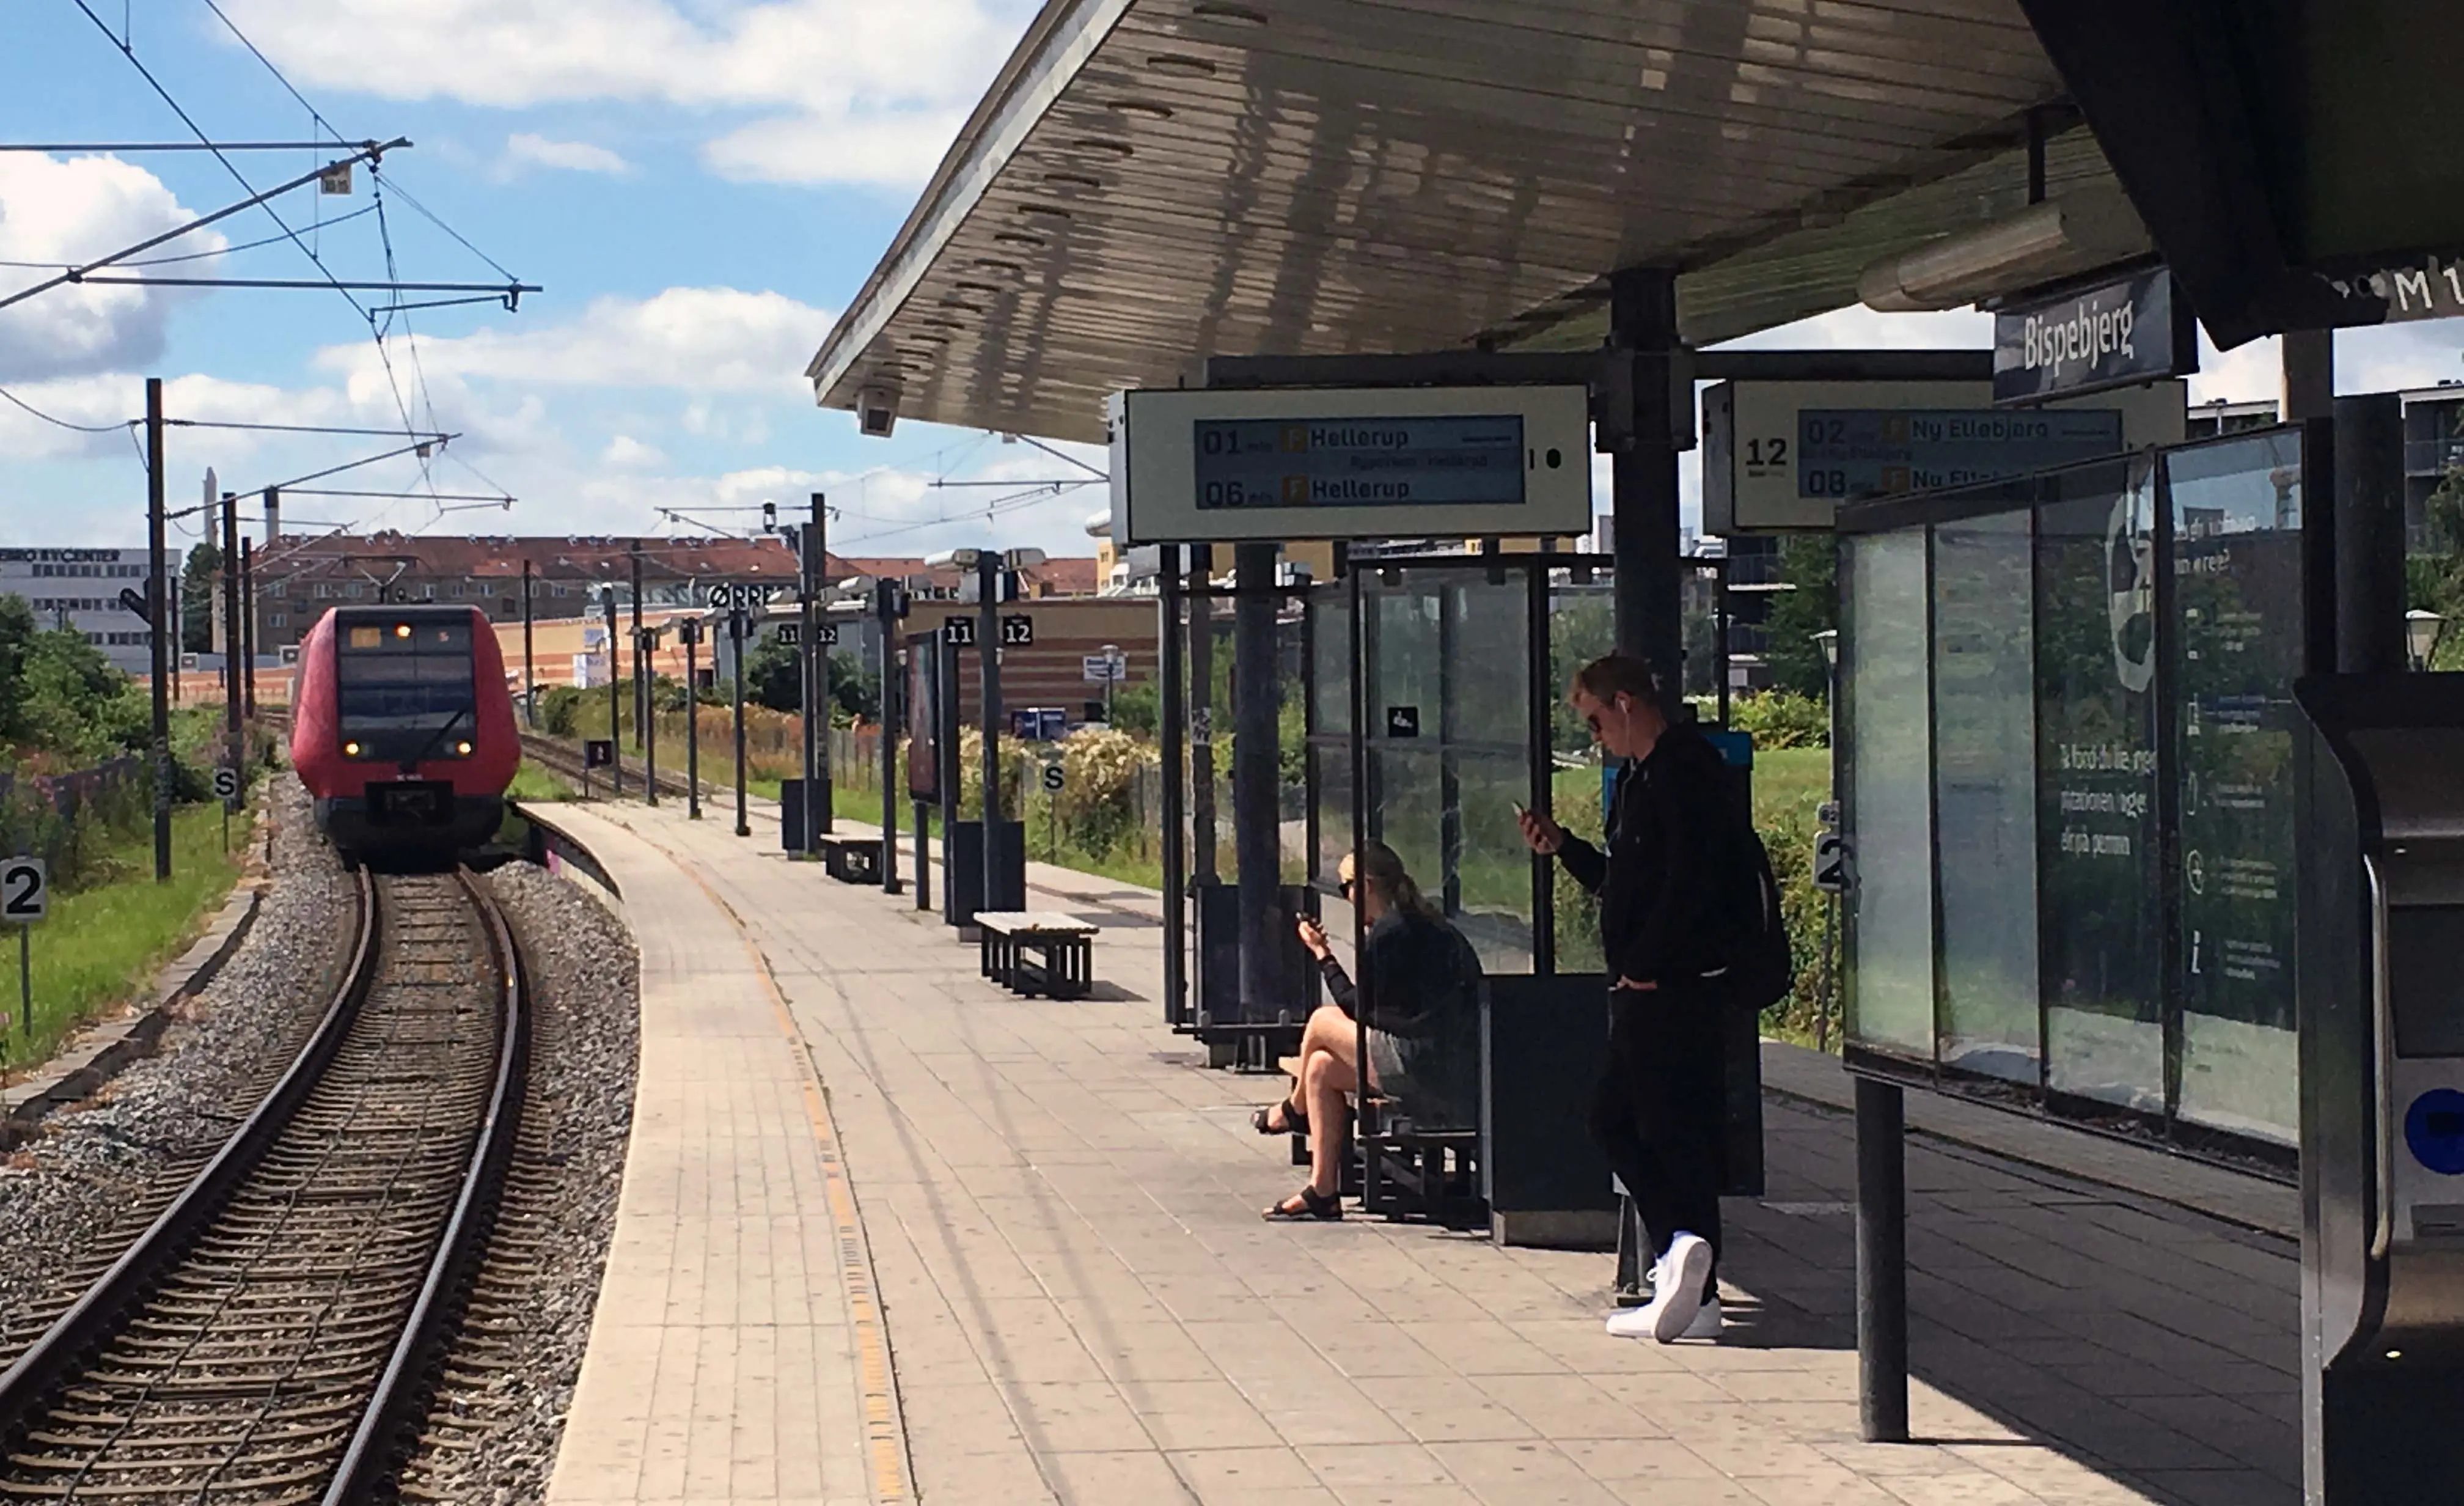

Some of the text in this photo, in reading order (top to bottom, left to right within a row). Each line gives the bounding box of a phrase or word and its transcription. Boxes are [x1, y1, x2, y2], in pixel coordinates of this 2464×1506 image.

[2025, 300, 2133, 377] Bispebjerg
[1204, 430, 1242, 455] 01
[1311, 428, 1409, 448] Hellerup
[1808, 419, 1846, 444] 02
[1913, 420, 1941, 440] Ny
[1746, 439, 1787, 465] 12
[1206, 481, 1244, 507] 06
[1313, 479, 1410, 499] Hellerup
[1809, 469, 1846, 494] 08
[780, 630, 796, 642] 11
[820, 630, 836, 642] 12
[948, 625, 972, 643] 11
[1006, 625, 1030, 643] 12
[216, 771, 235, 796] S
[1045, 766, 1065, 790] S
[1819, 839, 1854, 889] 2
[6, 865, 42, 914] 2
